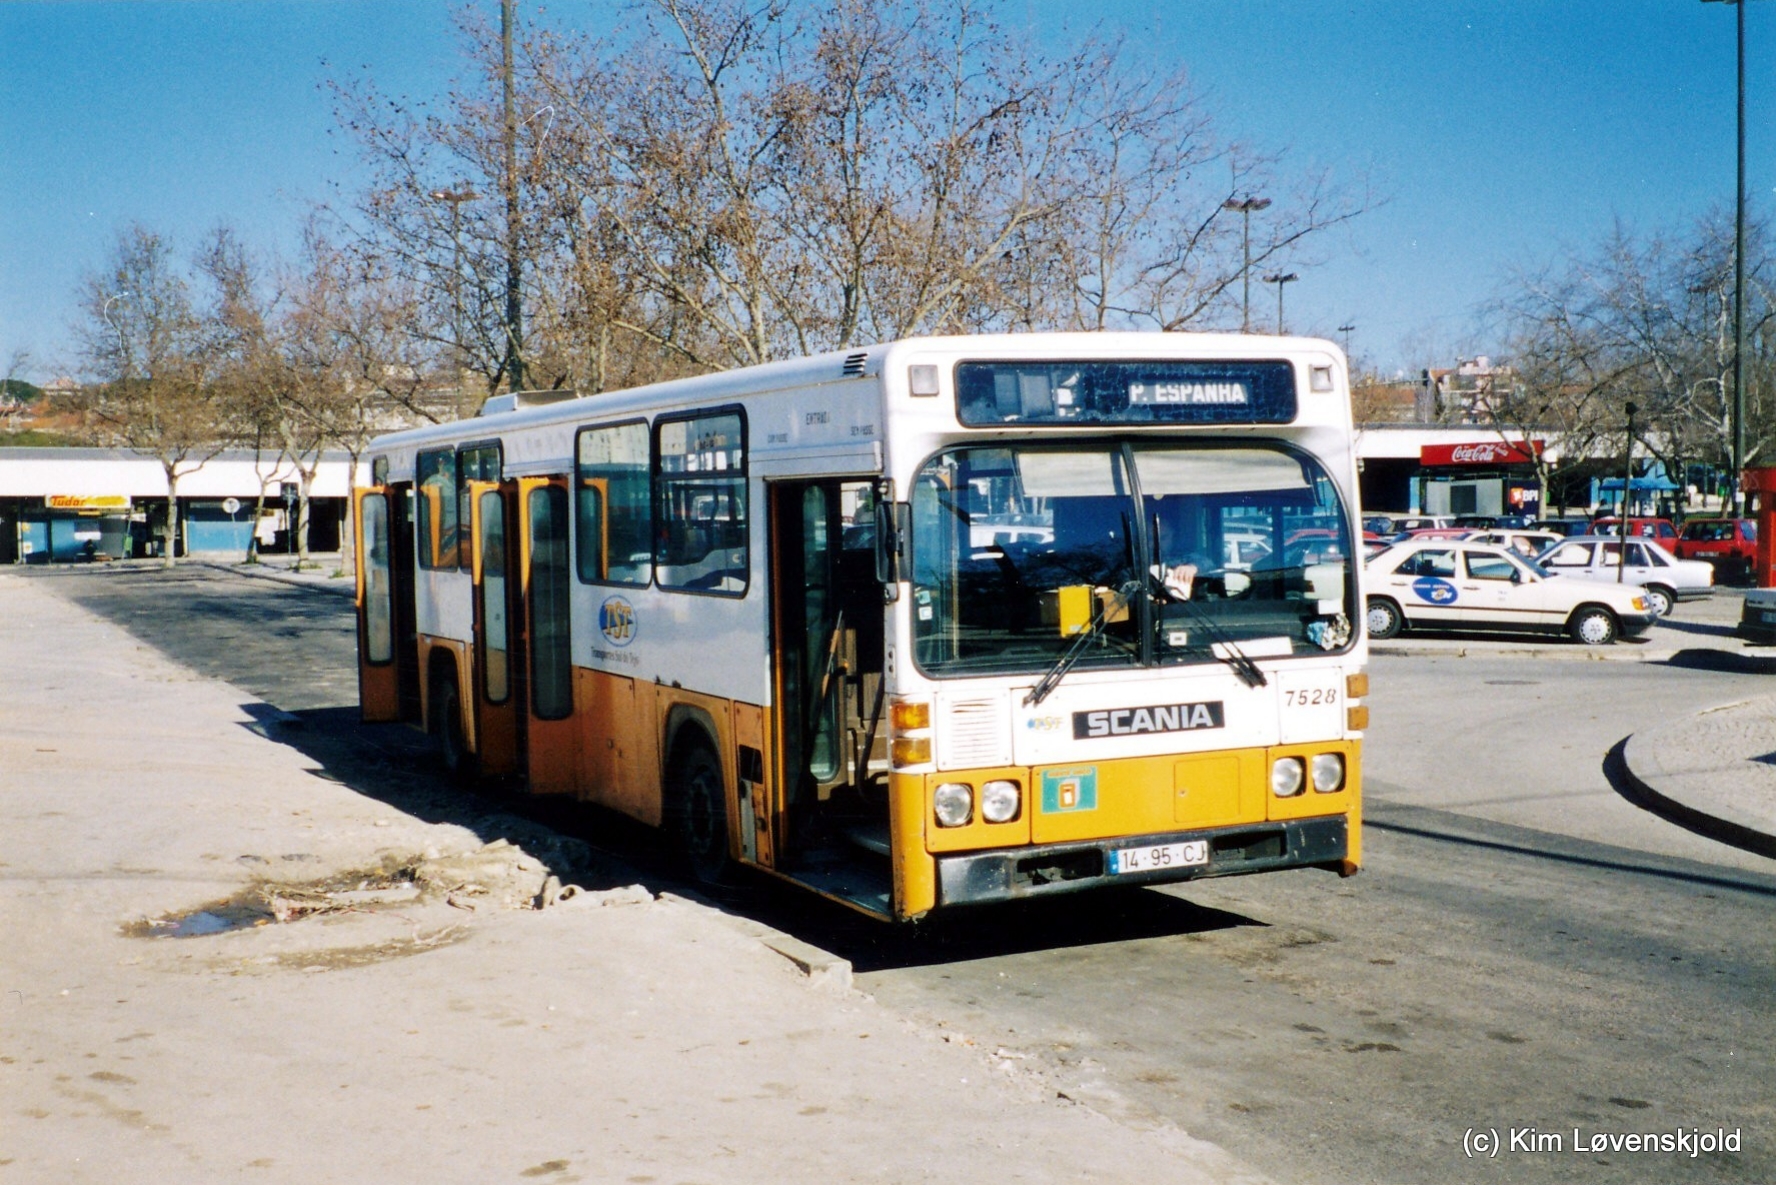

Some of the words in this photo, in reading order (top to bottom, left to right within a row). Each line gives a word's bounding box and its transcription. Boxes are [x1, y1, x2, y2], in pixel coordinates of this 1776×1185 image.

[1155, 383, 1245, 402] ESPANHA
[1452, 444, 1494, 462] Coca-Cola
[51, 495, 86, 506] Tudor
[1522, 489, 1539, 502] BPI
[605, 601, 632, 639] TST
[1285, 688, 1337, 707] 7528
[1087, 704, 1214, 737] SCANIA
